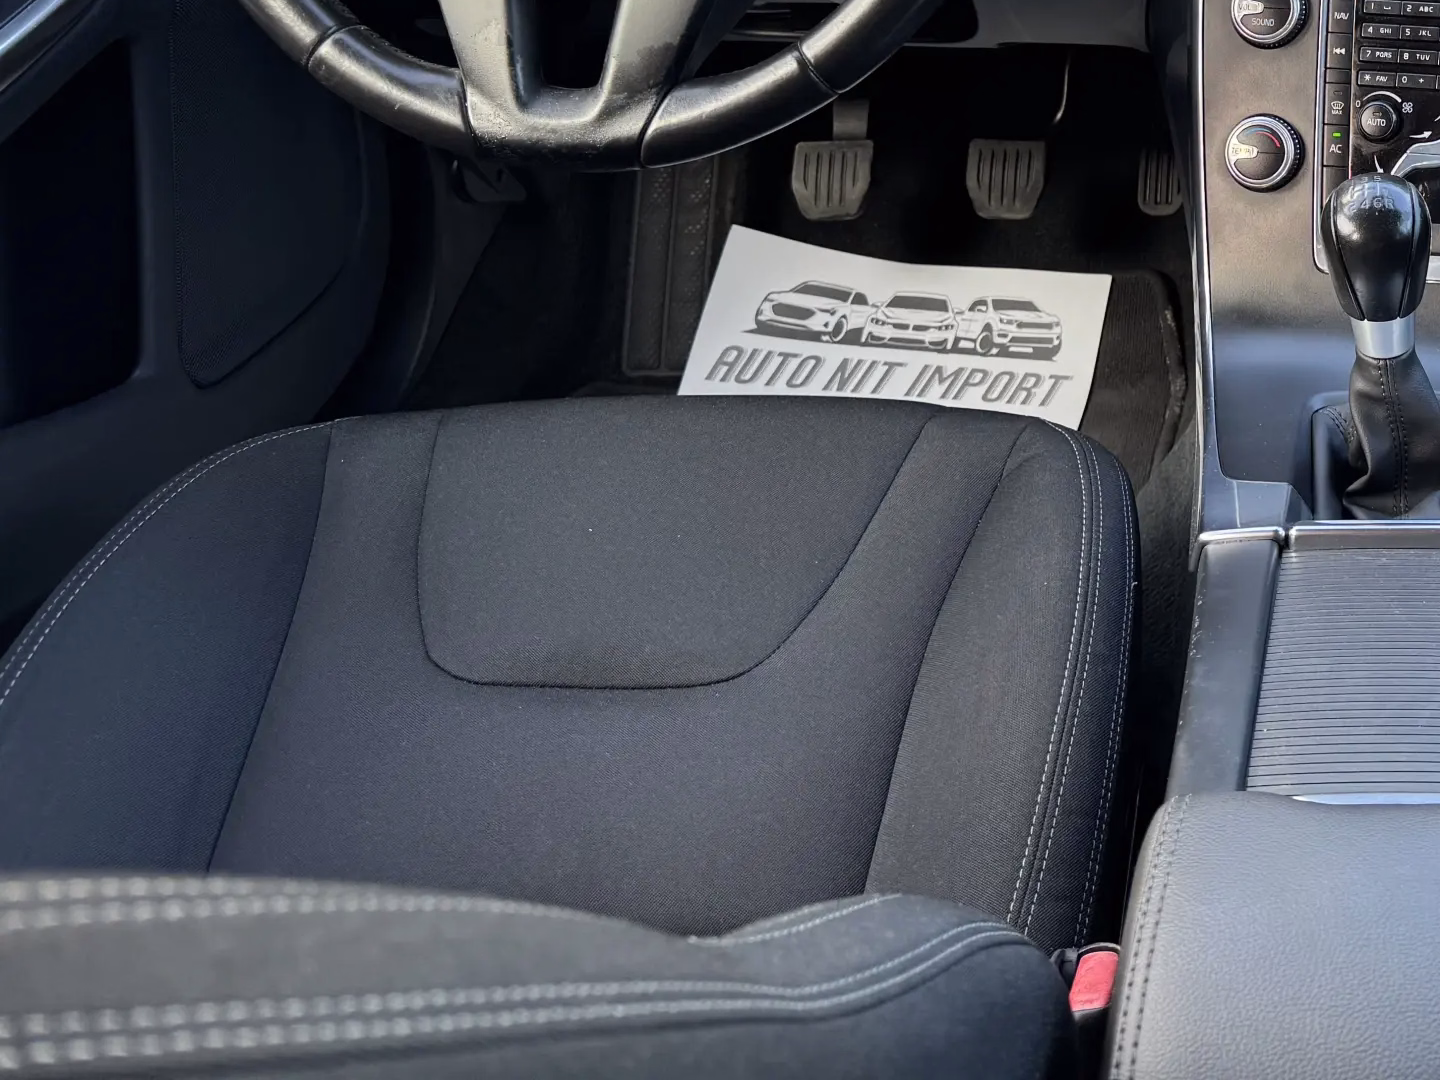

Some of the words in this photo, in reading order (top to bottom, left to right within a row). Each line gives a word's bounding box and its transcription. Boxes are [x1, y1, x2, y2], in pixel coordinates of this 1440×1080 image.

[1334, 12, 1350, 20] NAV
[1251, 18, 1275, 26] SOUND
[1375, 51, 1392, 59] PQRS
[1366, 119, 1386, 127] AUTO
[1329, 144, 1343, 154] AC
[704, 344, 826, 389] AUTO
[822, 356, 907, 395] NIT
[904, 364, 1074, 407] IMPORT
